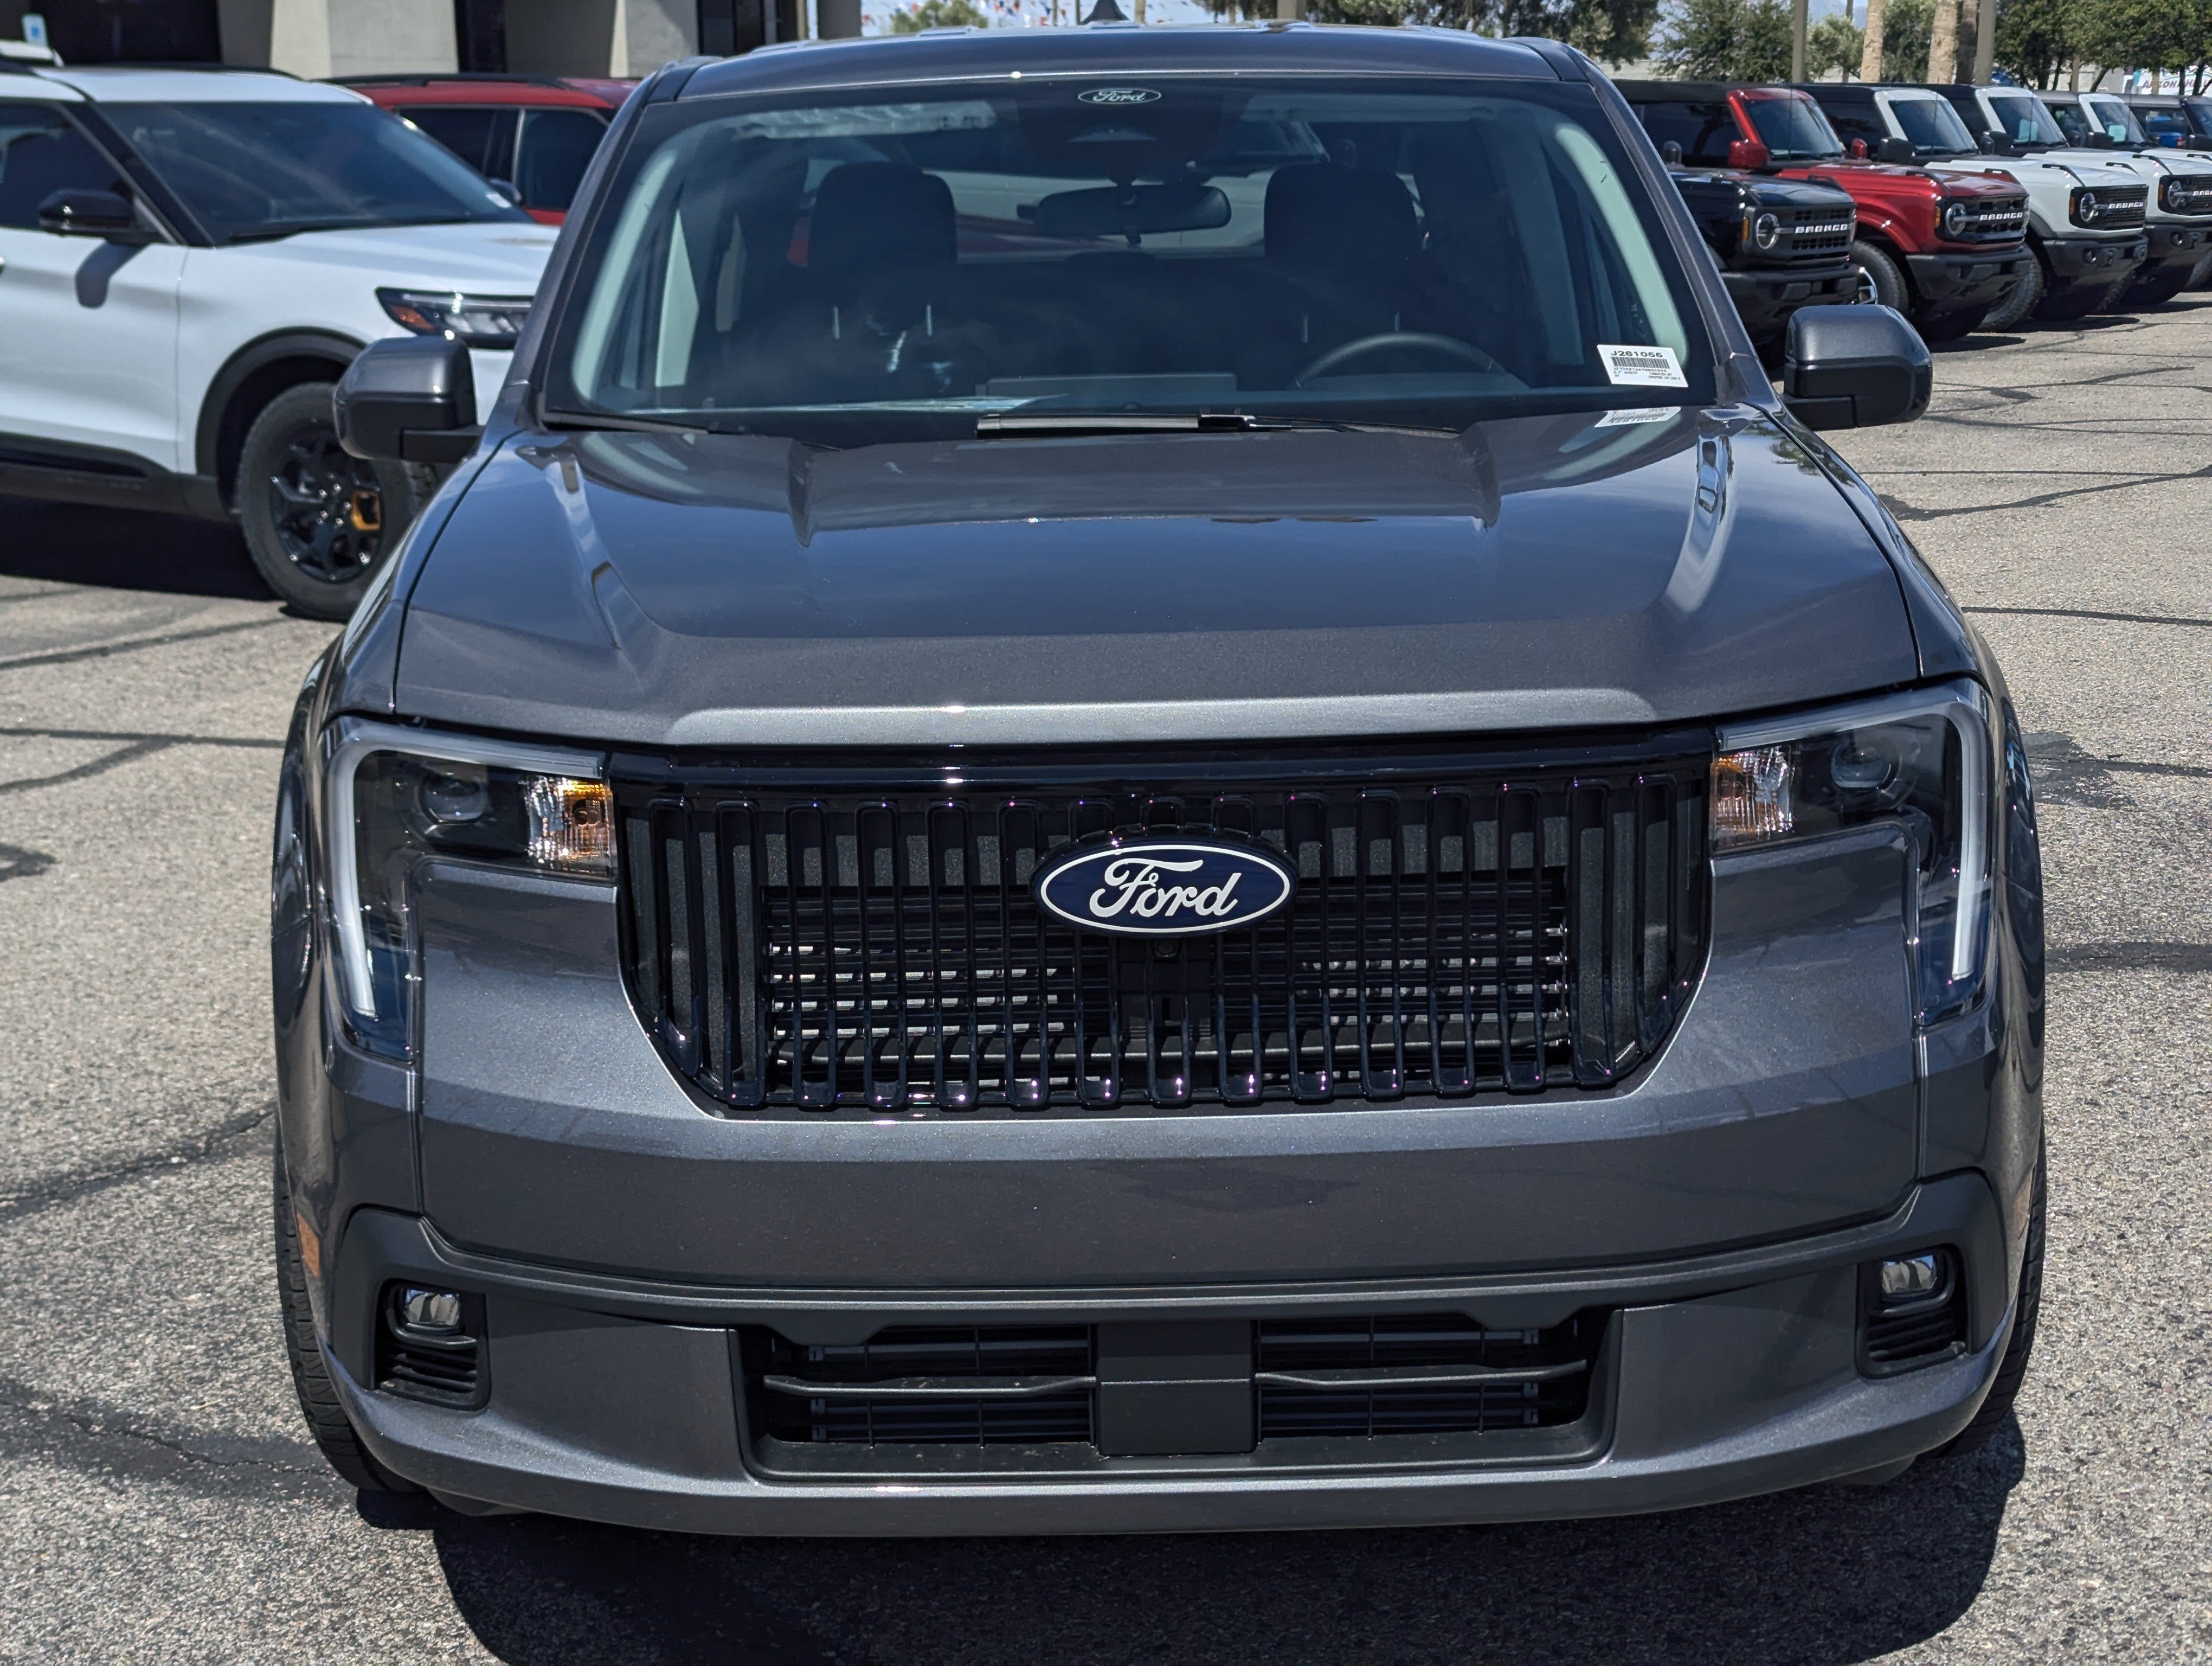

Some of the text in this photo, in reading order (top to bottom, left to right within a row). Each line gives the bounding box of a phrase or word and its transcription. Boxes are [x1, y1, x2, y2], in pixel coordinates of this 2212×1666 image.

[1092, 90, 1147, 101] Ford
[1980, 212, 2023, 221] BRONCO
[1795, 223, 1848, 234] BRONCO
[1089, 858, 1242, 918] Ford
